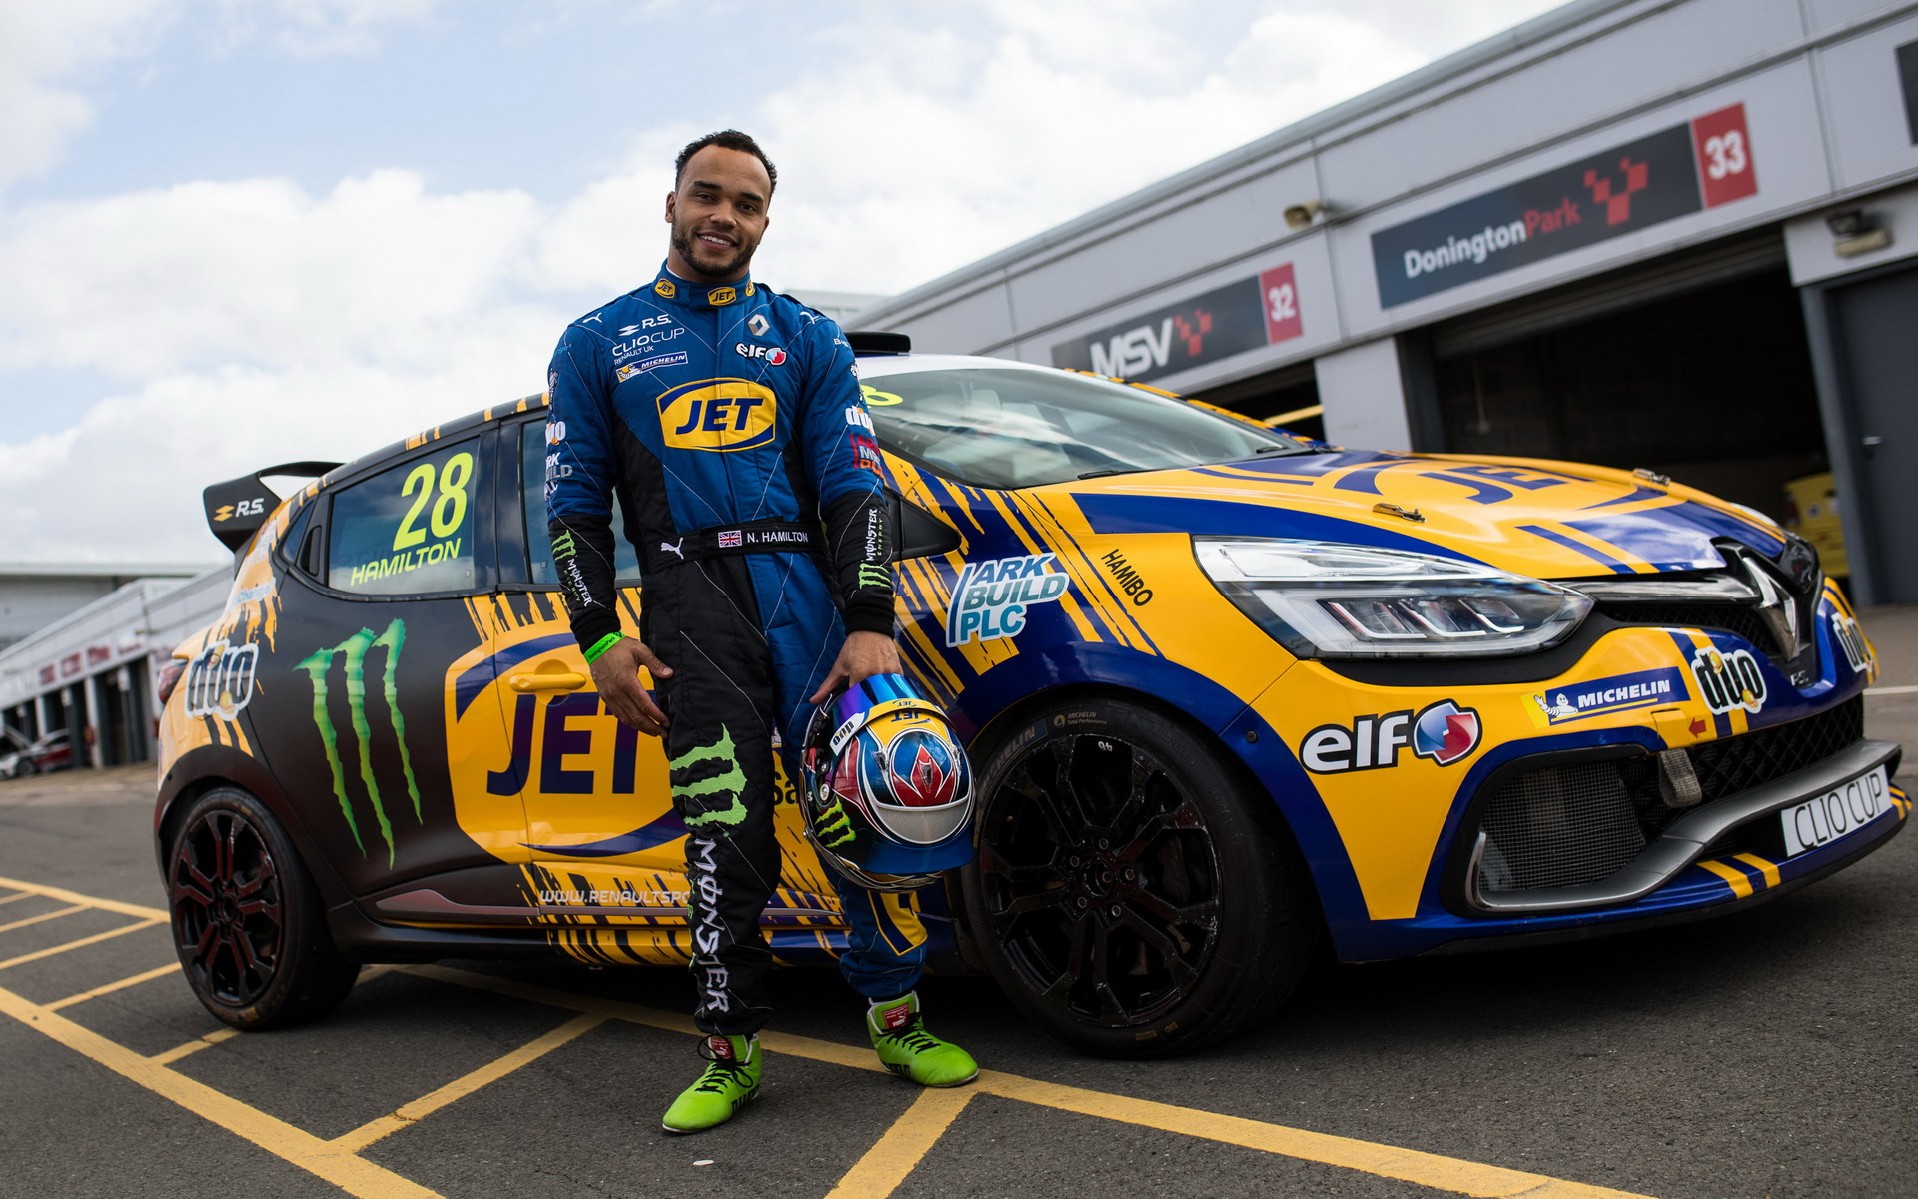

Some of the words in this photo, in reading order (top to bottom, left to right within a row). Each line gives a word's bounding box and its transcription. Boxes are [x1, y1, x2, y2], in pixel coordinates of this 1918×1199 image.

[1704, 130, 1747, 179] 33
[657, 282, 671, 293] JET
[713, 291, 731, 301] JET
[1268, 284, 1297, 322] 32
[614, 348, 642, 365] RENAULT
[643, 345, 654, 353] UK
[641, 354, 686, 369] MICHELIN
[736, 343, 766, 359] elf
[1090, 317, 1174, 378] MSV
[675, 398, 764, 435] JET
[393, 452, 474, 551] 28
[747, 533, 758, 543] N.
[762, 531, 809, 543] HAMILTON
[865, 508, 877, 561] MONSTER
[350, 538, 462, 587] HAMILTON
[968, 556, 1054, 586] ARK
[568, 559, 592, 607] MONSTER
[962, 575, 1066, 611] BUILD
[960, 605, 1025, 642] PLC
[1577, 679, 1671, 708] MICHELIN
[1693, 649, 1765, 710] duo
[832, 721, 854, 746] duo
[891, 711, 920, 723] JET
[1068, 711, 1097, 719] MICHELIN
[486, 690, 657, 797] JET
[1302, 714, 1409, 770] elf
[1794, 792, 1847, 850] CLIO
[1847, 772, 1882, 824] CUP
[693, 838, 731, 1013] MONSTER
